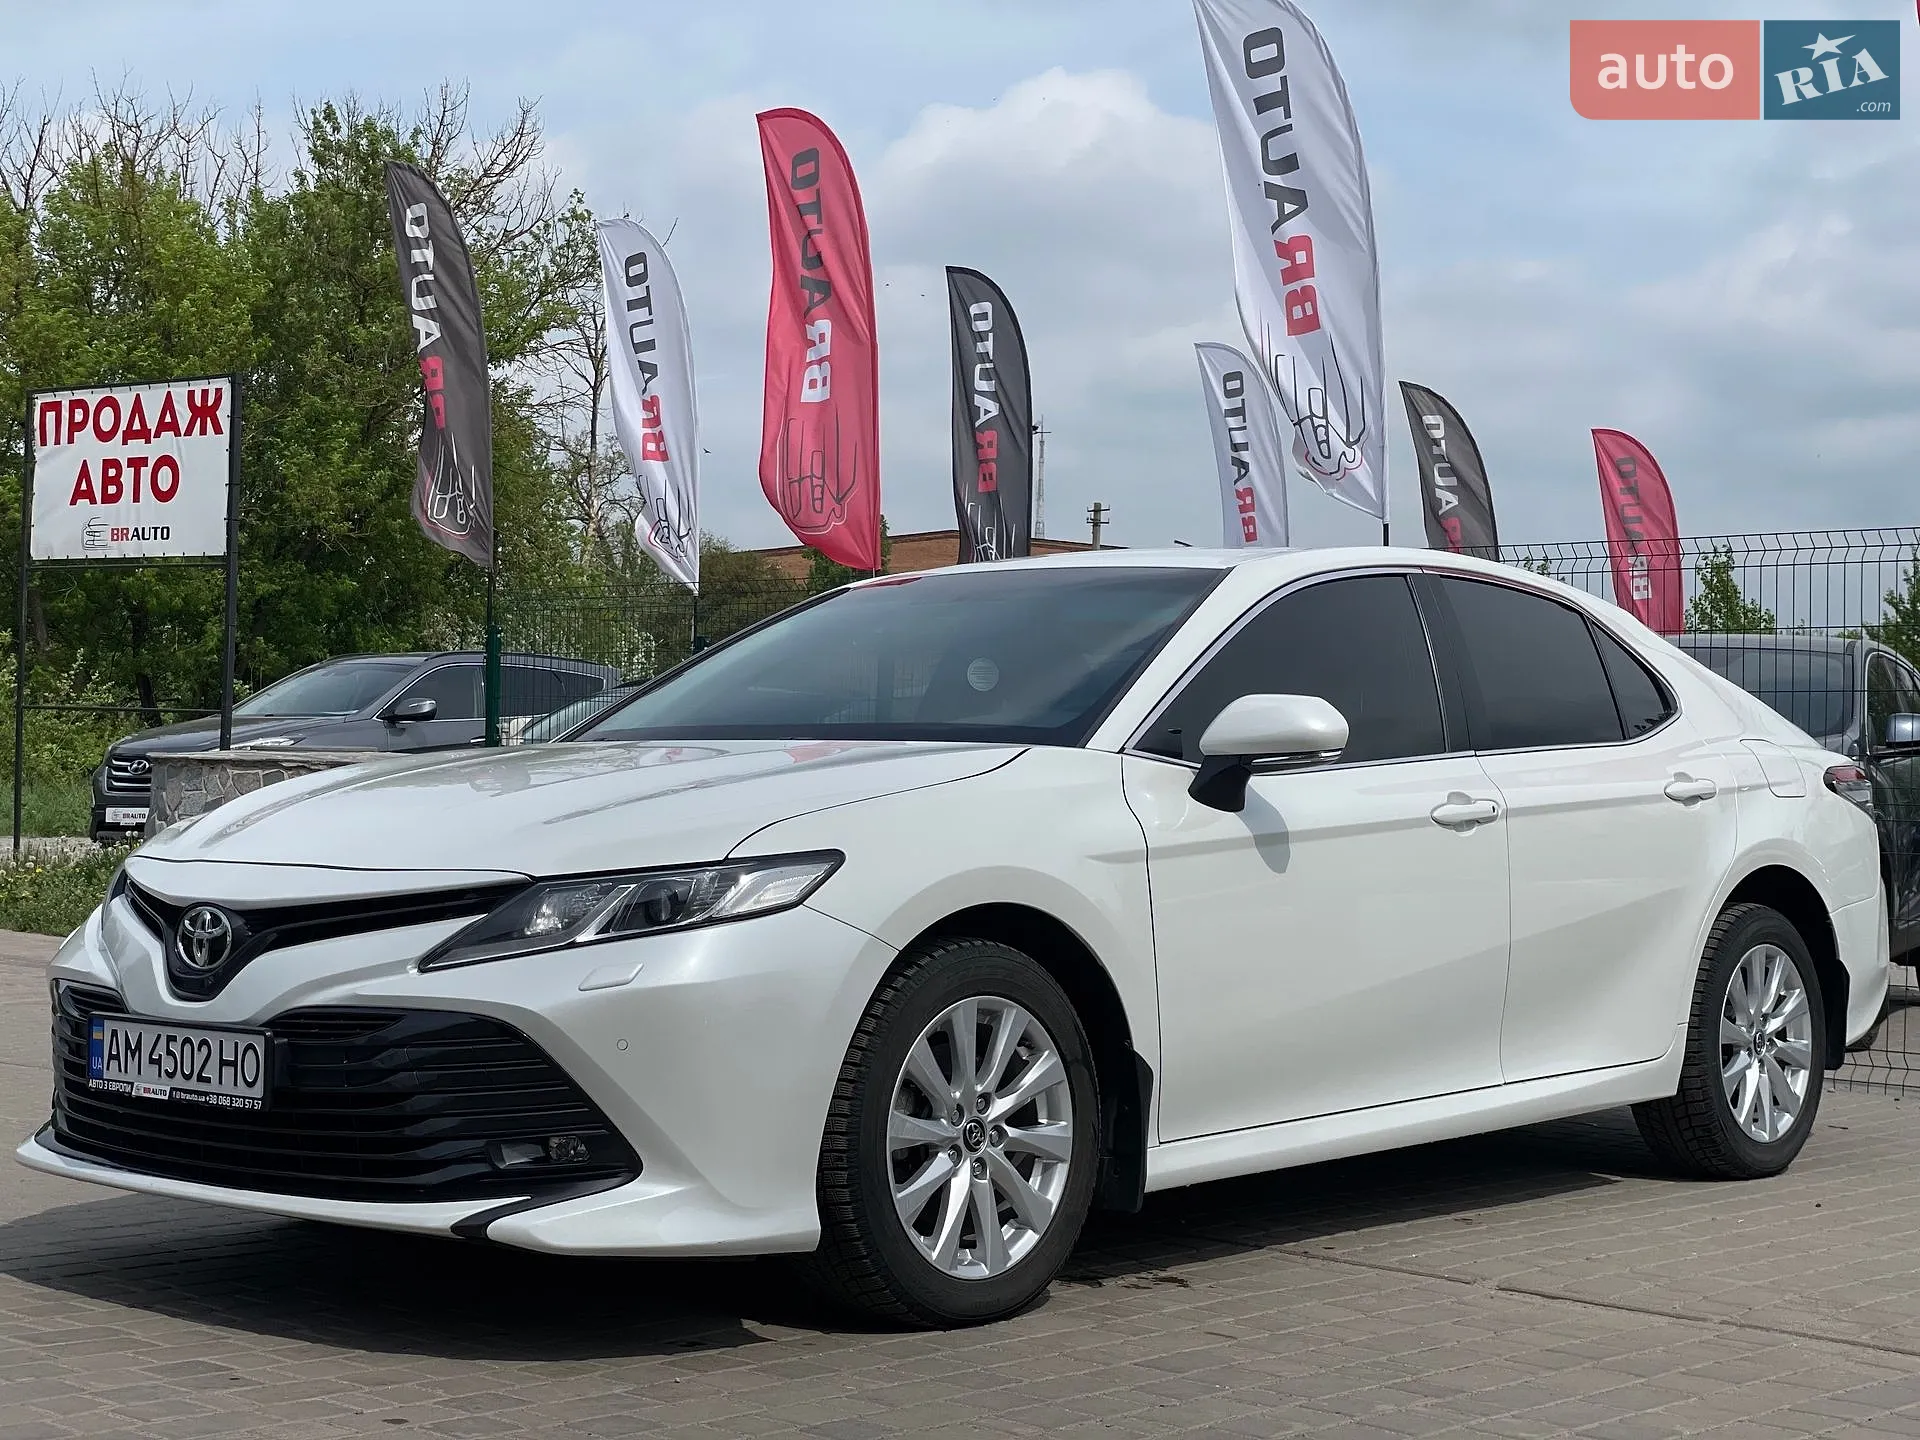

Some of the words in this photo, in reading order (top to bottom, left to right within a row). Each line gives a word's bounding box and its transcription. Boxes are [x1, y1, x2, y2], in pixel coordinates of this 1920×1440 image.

[38, 387, 224, 447] ПРОДАЖ
[69, 454, 181, 506] АВТО
[110, 526, 170, 542] BRAUTO
[92, 1055, 103, 1071] UA
[106, 1028, 143, 1076] AM
[148, 1032, 213, 1084] 4502
[218, 1038, 261, 1089] HO
[143, 1087, 167, 1097] BRAUTO
[206, 1094, 218, 1105] +38
[218, 1095, 231, 1107] 068
[231, 1097, 244, 1108] 320
[244, 1100, 253, 1109] 57
[253, 1100, 262, 1111] 57
